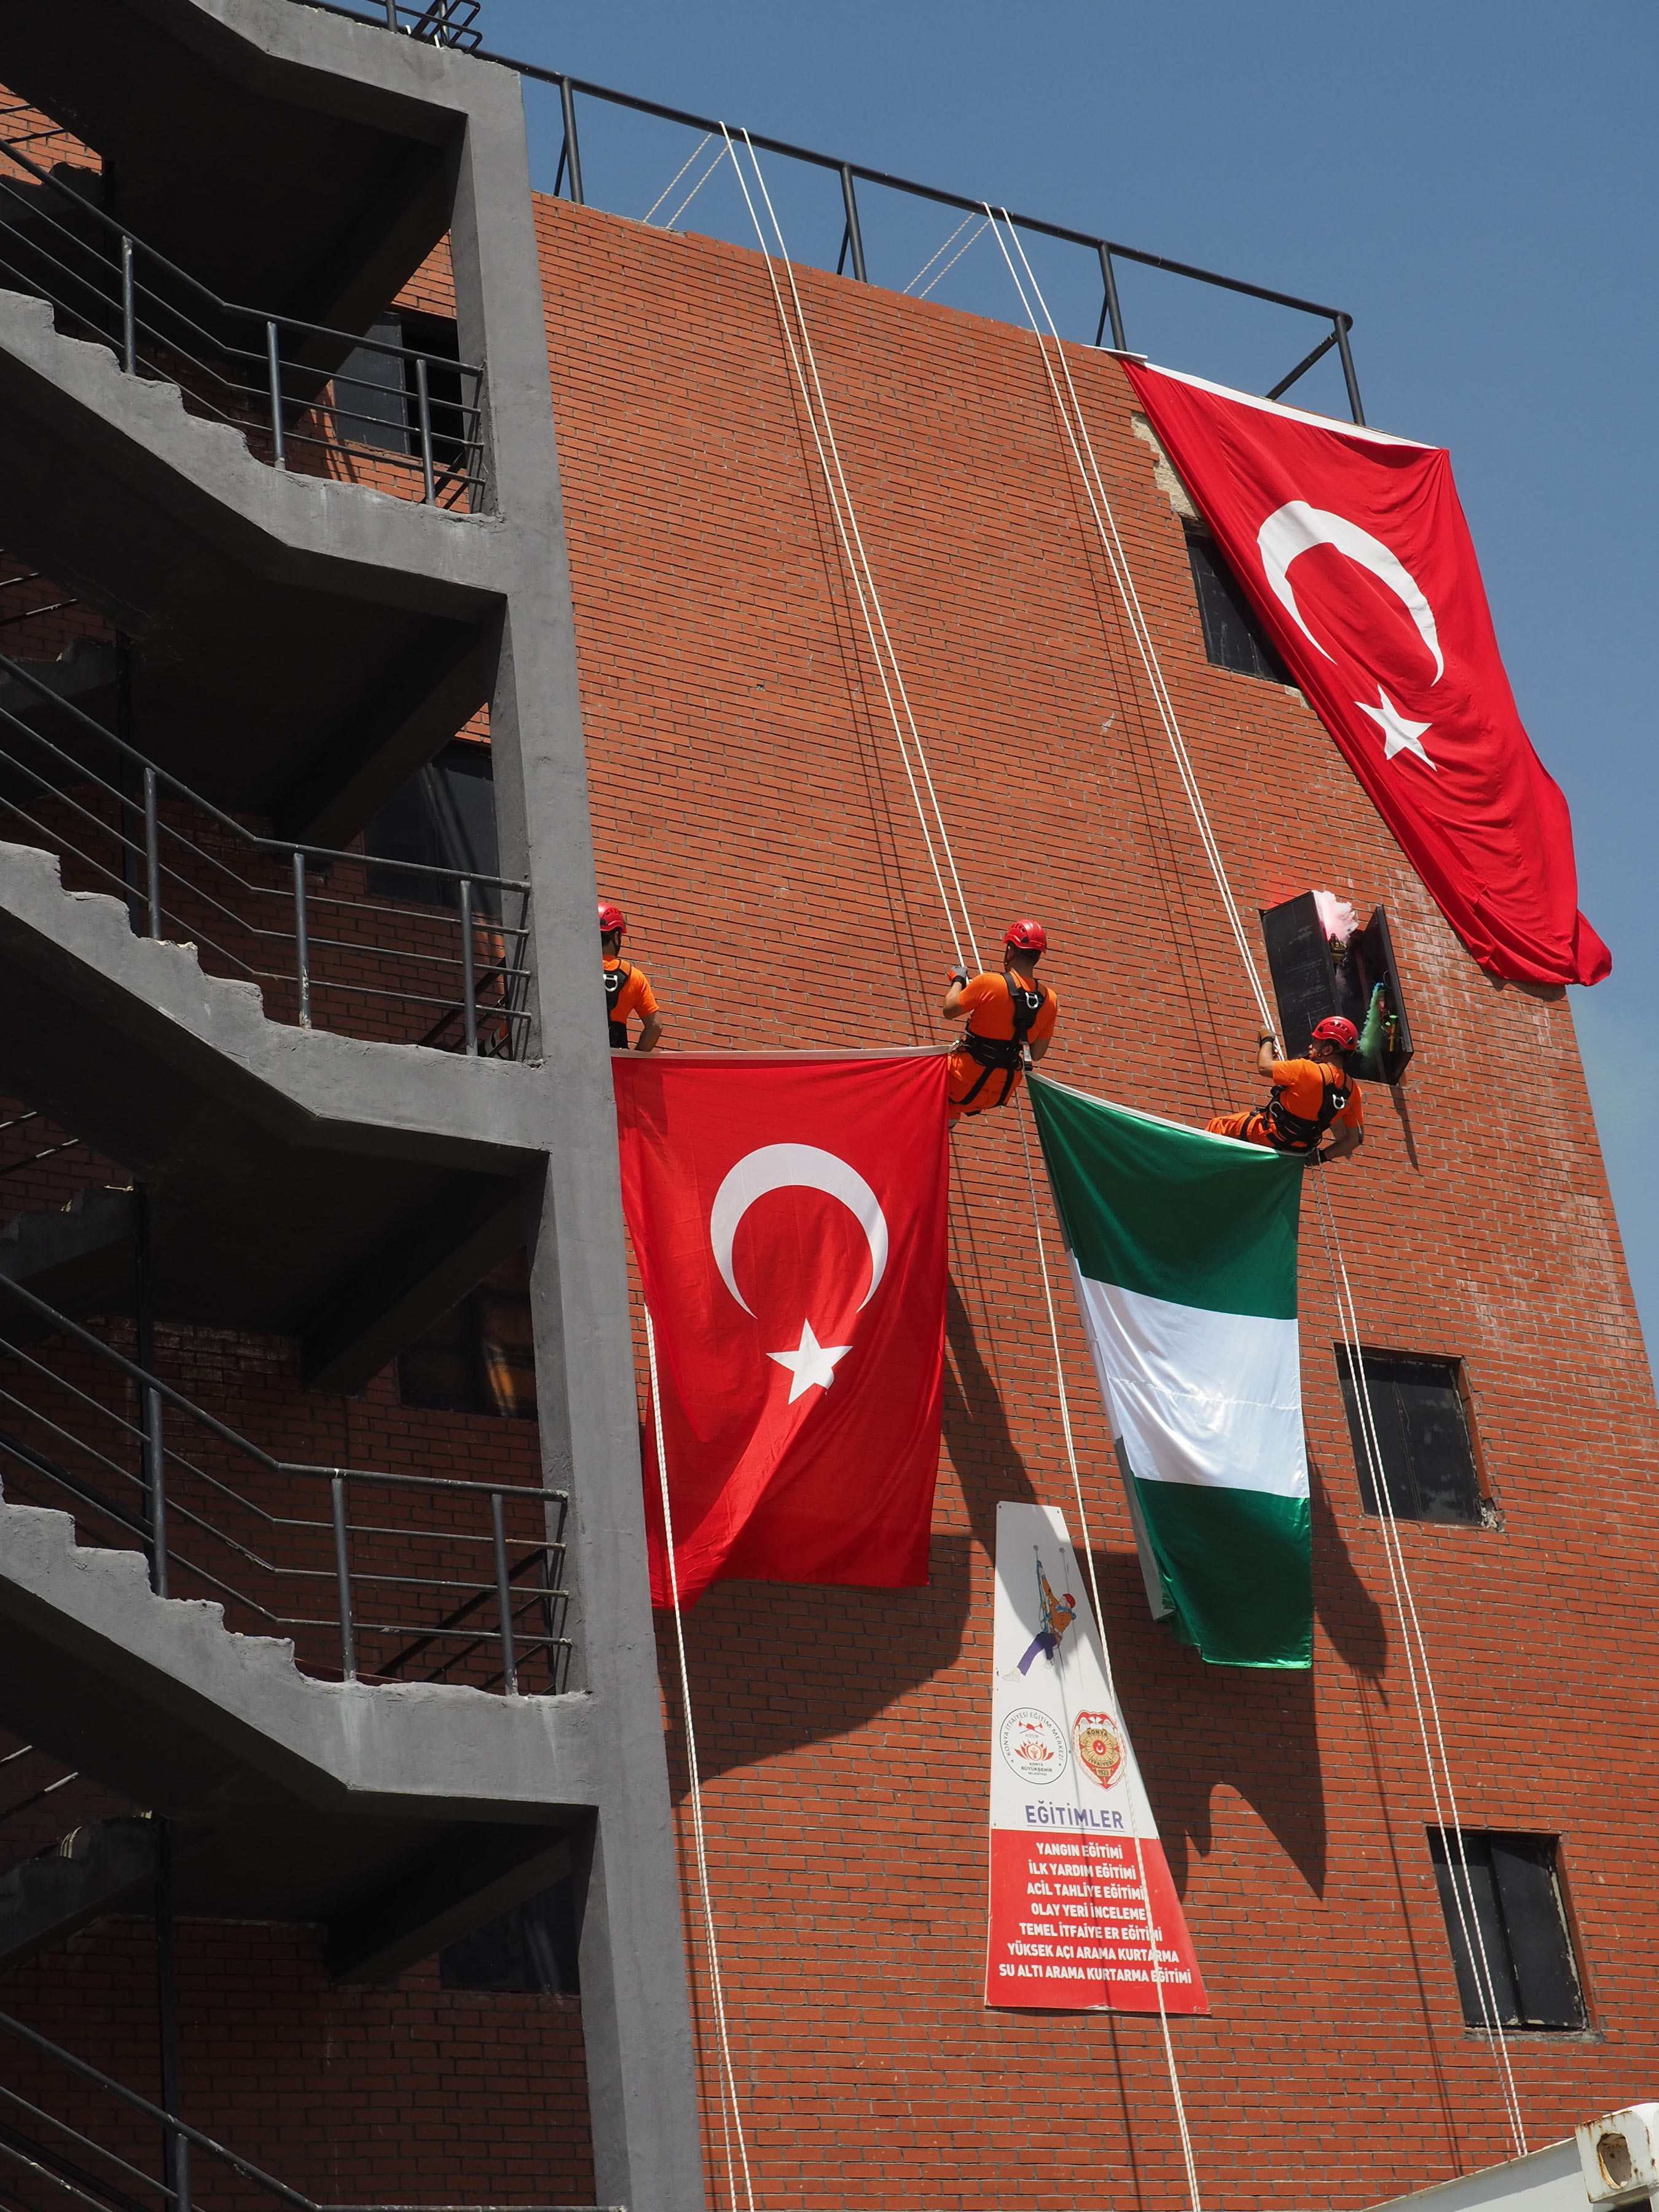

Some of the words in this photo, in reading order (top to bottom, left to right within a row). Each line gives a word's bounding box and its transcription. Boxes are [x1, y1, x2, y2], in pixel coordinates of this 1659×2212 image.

[1025, 1800, 1124, 1829] EĞİTİMLER
[1035, 1842, 1080, 1857] YANGIN
[1081, 1841, 1123, 1859] EĞİTİMİ
[1028, 1859, 1049, 1875] İLK
[1049, 1863, 1094, 1877] YARDIM
[1095, 1862, 1136, 1880] EĞİTİMİ
[1027, 1880, 1053, 1896] ACİL
[1054, 1881, 1102, 1898] TAHLİYE
[1104, 1883, 1145, 1900] EĞİTİMİ
[1031, 1902, 1060, 1916] OLAY
[1062, 1902, 1088, 1918] YERİ
[1090, 1902, 1147, 1920] İNCELEME
[1019, 1922, 1058, 1937] TEMEL
[1058, 1921, 1103, 1939] İTFAİYE
[1104, 1926, 1120, 1940] ER
[1007, 1939, 1054, 1957] YÜKSEK
[1056, 1945, 1075, 1959] AÇI
[1077, 1946, 1116, 1960] ARAMA
[1118, 1948, 1180, 1963] KURTARMA
[998, 1963, 1015, 1977] SU
[1017, 1964, 1043, 1978] ALTI
[1045, 1965, 1086, 1980] ARAMA
[1086, 1967, 1150, 1982] KURTARMA
[1150, 1967, 1192, 1984] EĞİTİMİ
